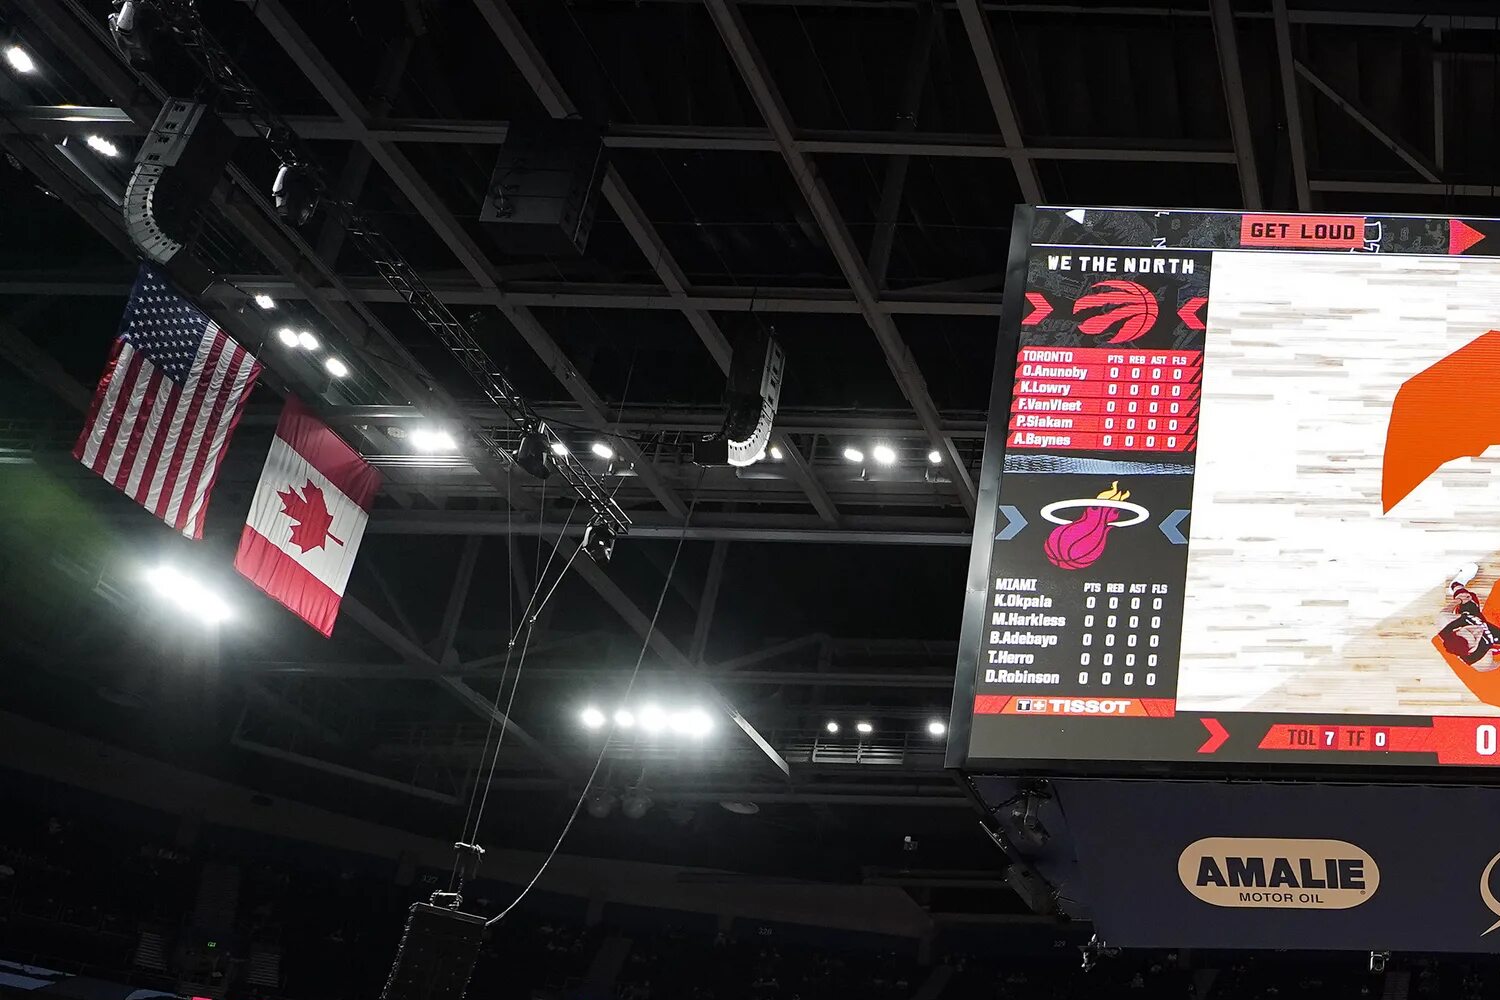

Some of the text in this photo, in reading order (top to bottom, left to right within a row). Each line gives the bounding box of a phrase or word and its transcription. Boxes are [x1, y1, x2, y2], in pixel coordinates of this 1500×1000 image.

[1250, 222, 1356, 241] GET LOUD
[1047, 255, 1195, 275] WE THE NORTH
[1022, 350, 1187, 365] TORONTO PTS REB AST FLS
[1022, 364, 1182, 380] O.Anunoby 0 0 0 0
[1020, 380, 1071, 396] K.Lowry
[1018, 398, 1082, 412] F.VanVleet
[1016, 415, 1073, 429] P.Siakam
[1013, 432, 1071, 447] A.Baynes
[995, 578, 1168, 594] MIAMI PTS REB AST FLS
[1086, 596, 1096, 609] 0
[1109, 597, 1118, 609] 0
[1130, 597, 1140, 610] 0
[1153, 597, 1162, 610] 0
[992, 612, 1066, 627] M.Harkless
[990, 631, 1058, 647] B.Adebayo
[988, 650, 1034, 665] T.Herro
[985, 669, 1060, 684] D.Robinson
[1048, 700, 1131, 714] TISSOT
[1287, 729, 1386, 747] TOL 7 TF 0
[1475, 724, 1498, 755] 0
[1195, 856, 1366, 891] AMALIE
[1238, 892, 1324, 904] MOTOR OIL
